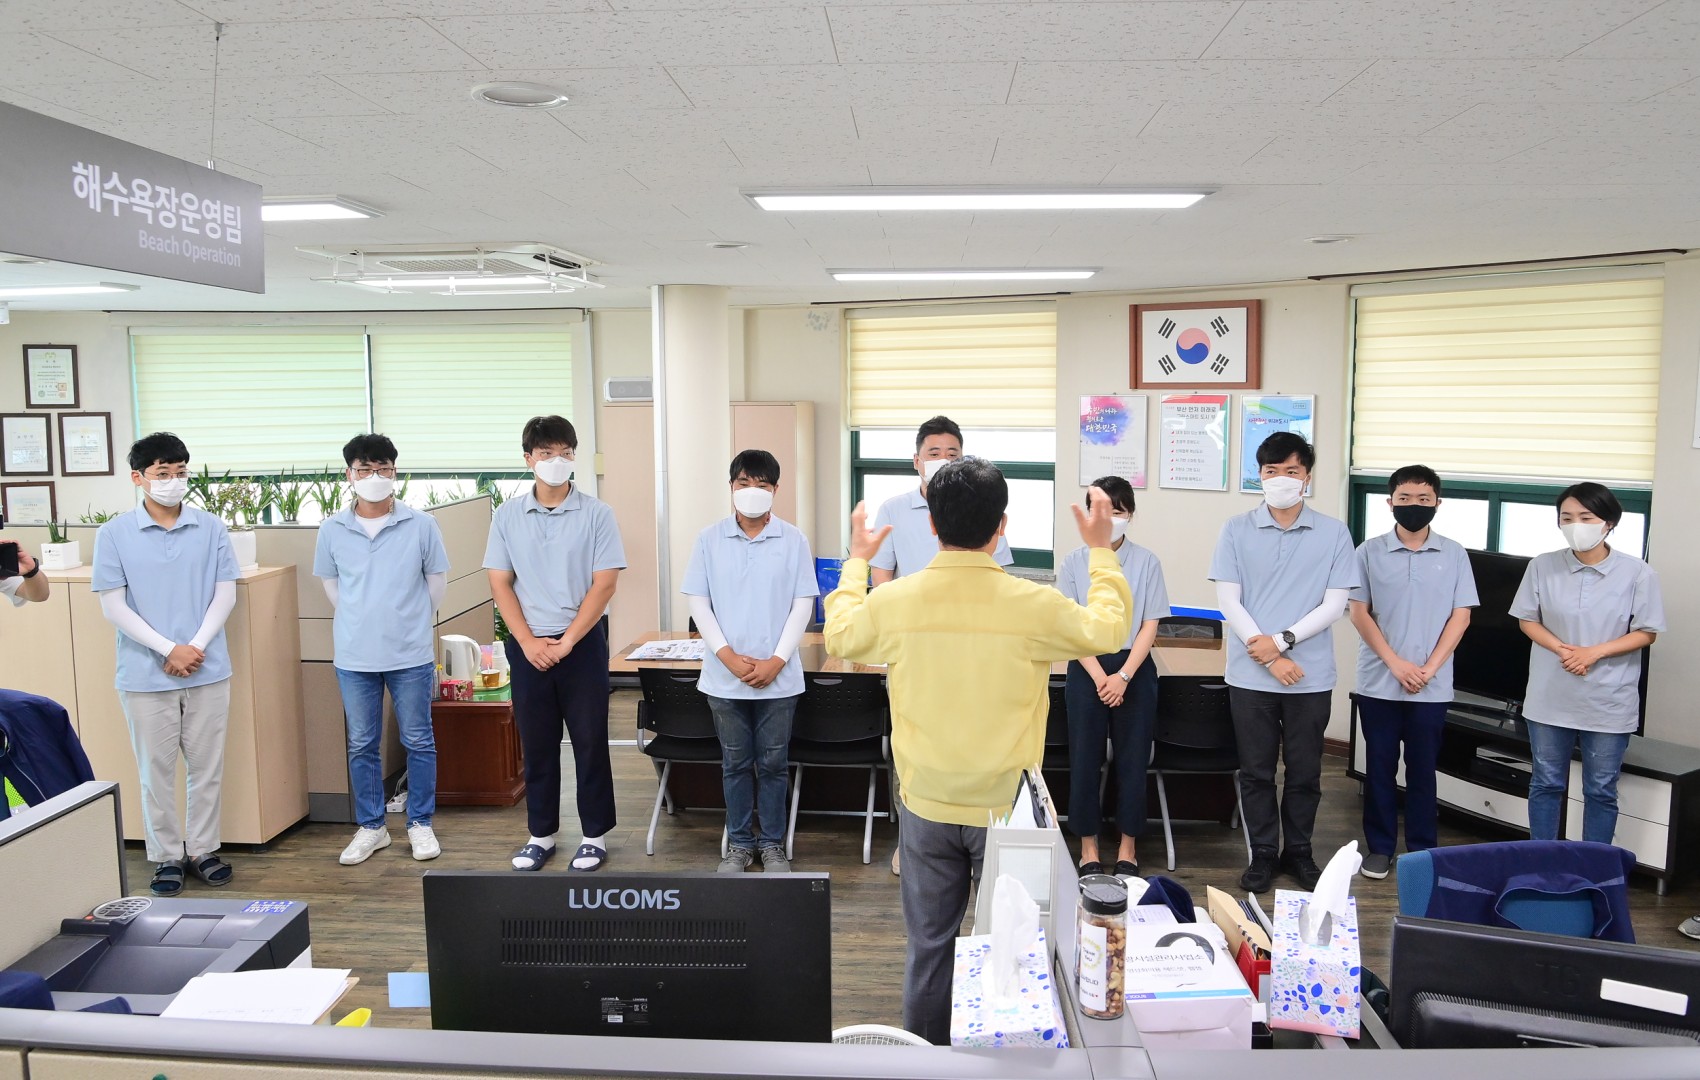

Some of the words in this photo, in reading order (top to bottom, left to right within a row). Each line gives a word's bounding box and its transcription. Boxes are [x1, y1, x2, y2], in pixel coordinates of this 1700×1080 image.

[72, 161, 242, 244] 해수욕장운영팀
[139, 230, 179, 256] Beach
[183, 240, 241, 267] Operation
[568, 888, 681, 910] LUCOMS
